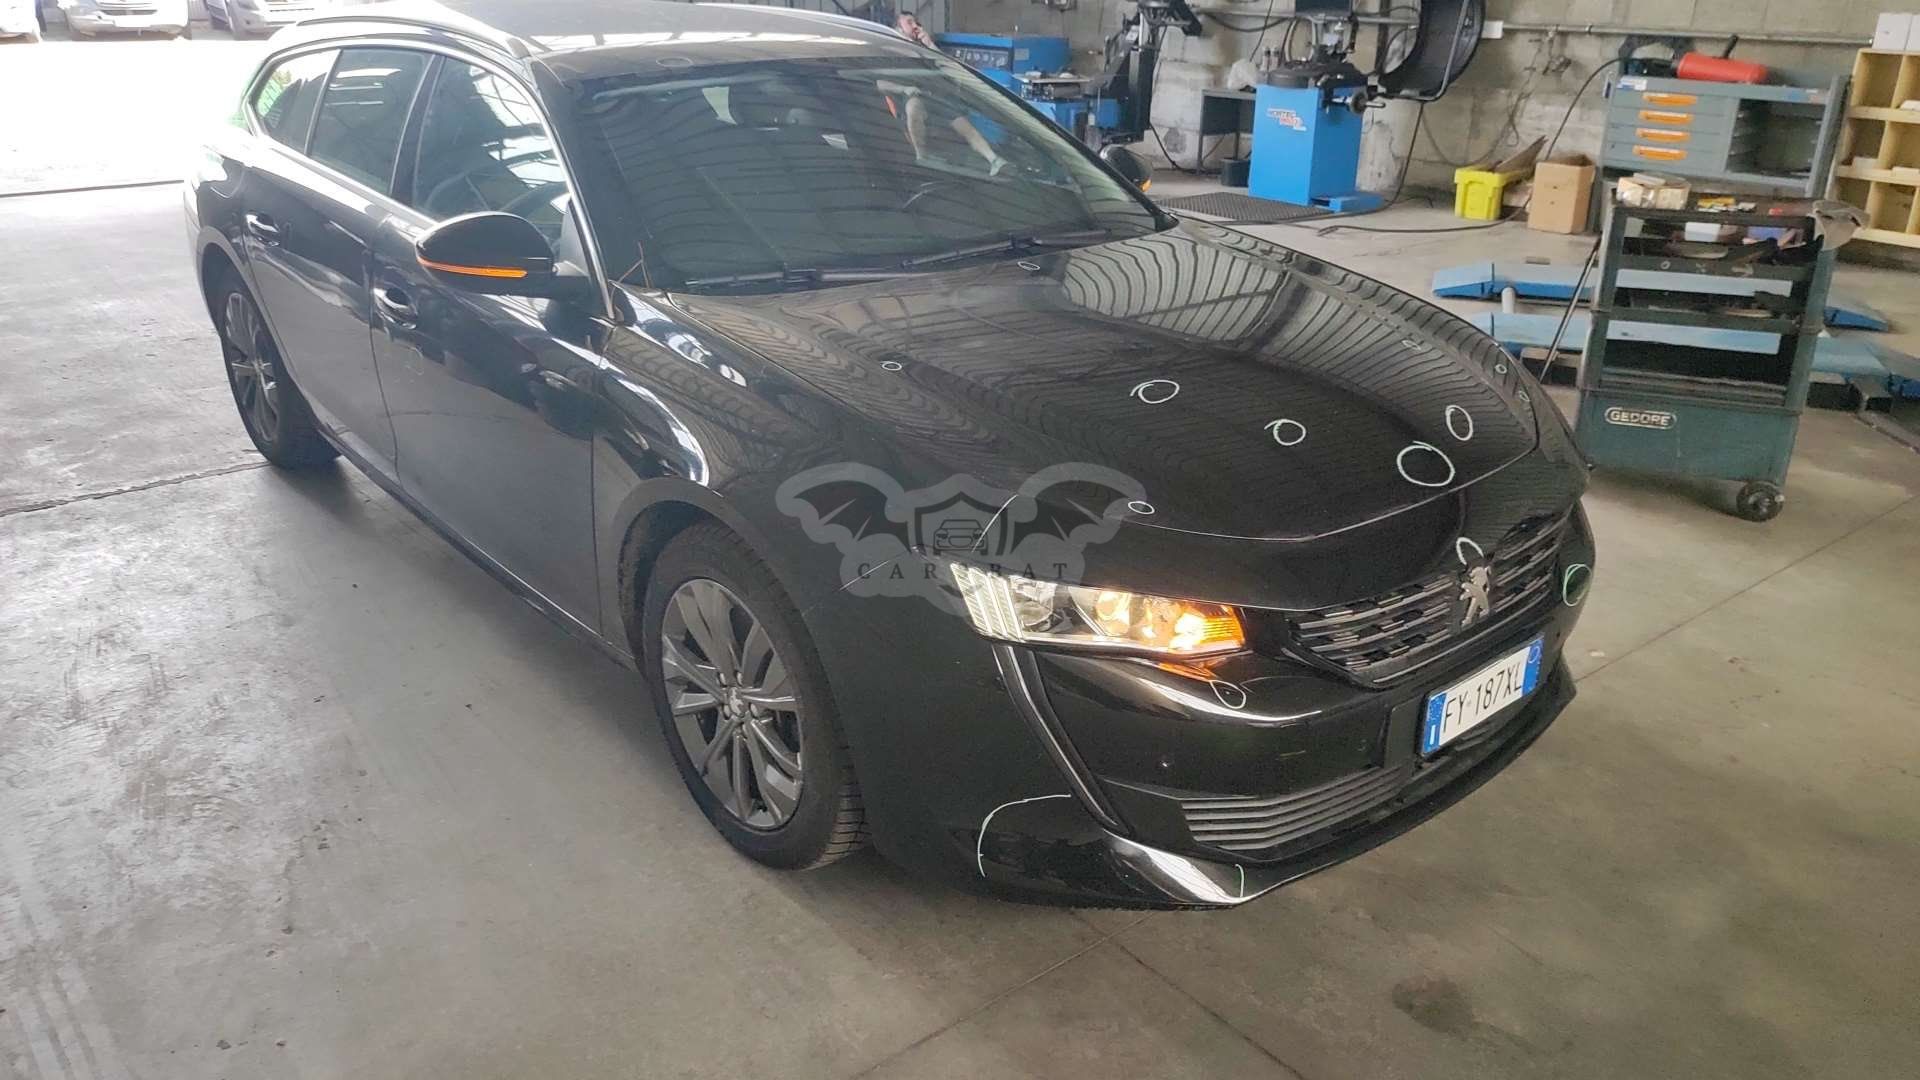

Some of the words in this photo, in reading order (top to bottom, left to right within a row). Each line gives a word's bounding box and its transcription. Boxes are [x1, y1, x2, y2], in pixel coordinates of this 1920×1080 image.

[1610, 410, 1671, 426] GEDORE
[1443, 690, 1468, 733] FY
[1475, 662, 1522, 716] 187XL
